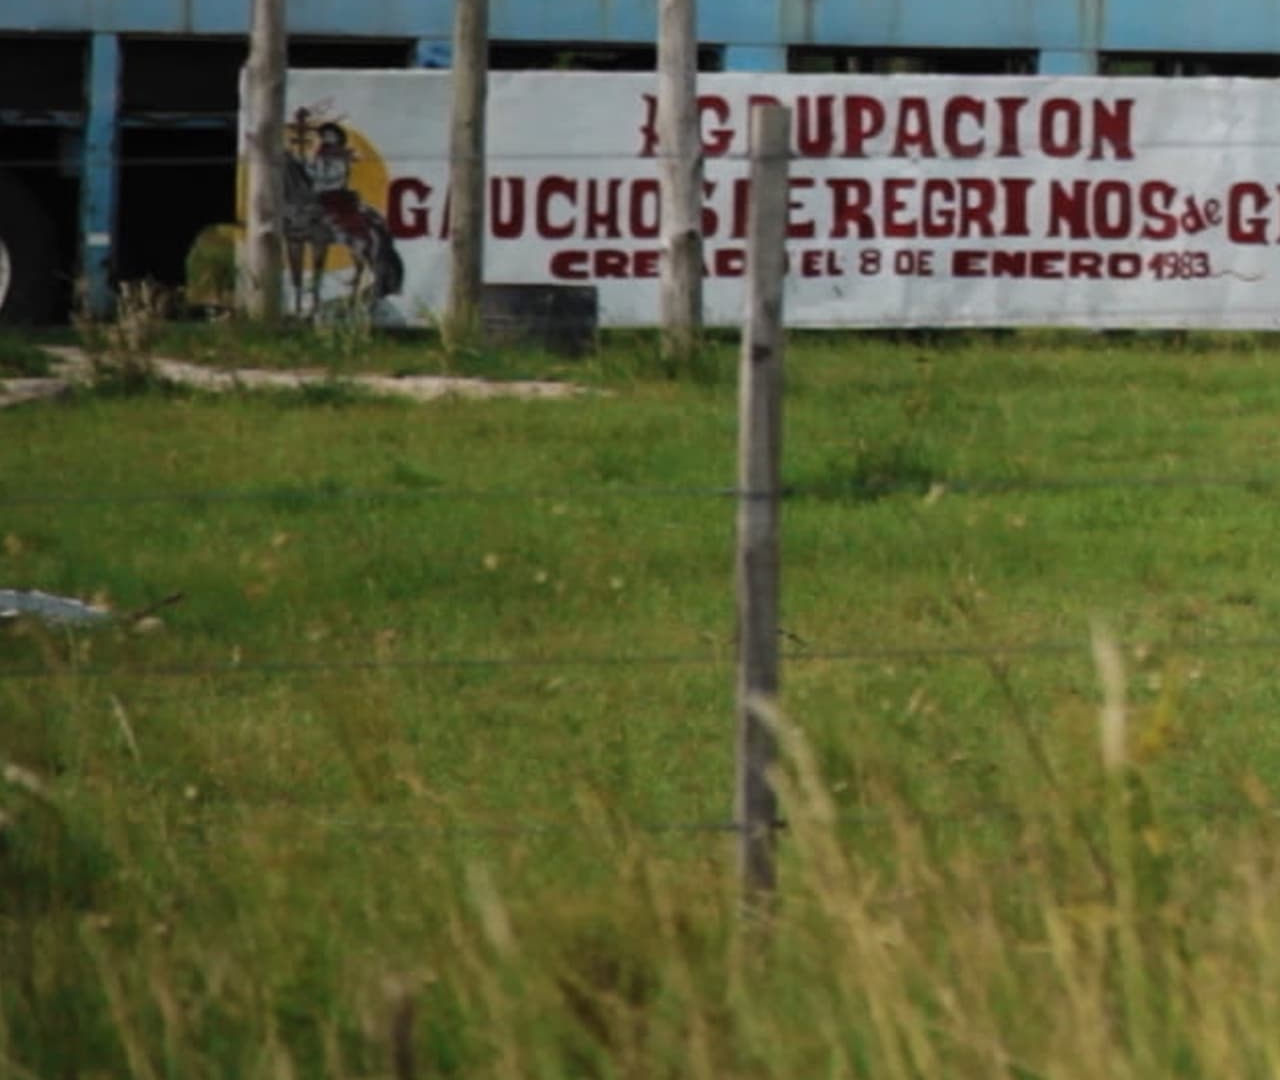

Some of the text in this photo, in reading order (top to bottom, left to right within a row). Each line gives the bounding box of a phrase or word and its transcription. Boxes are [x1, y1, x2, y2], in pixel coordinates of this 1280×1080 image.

[638, 92, 1135, 160] GUPACION
[386, 174, 718, 240] GUCHO
[1180, 193, 1222, 234] de
[550, 248, 790, 280] CRED
[802, 249, 843, 277] EL
[858, 248, 881, 276] 8
[894, 249, 934, 276] DE
[952, 250, 1142, 280] ENERO
